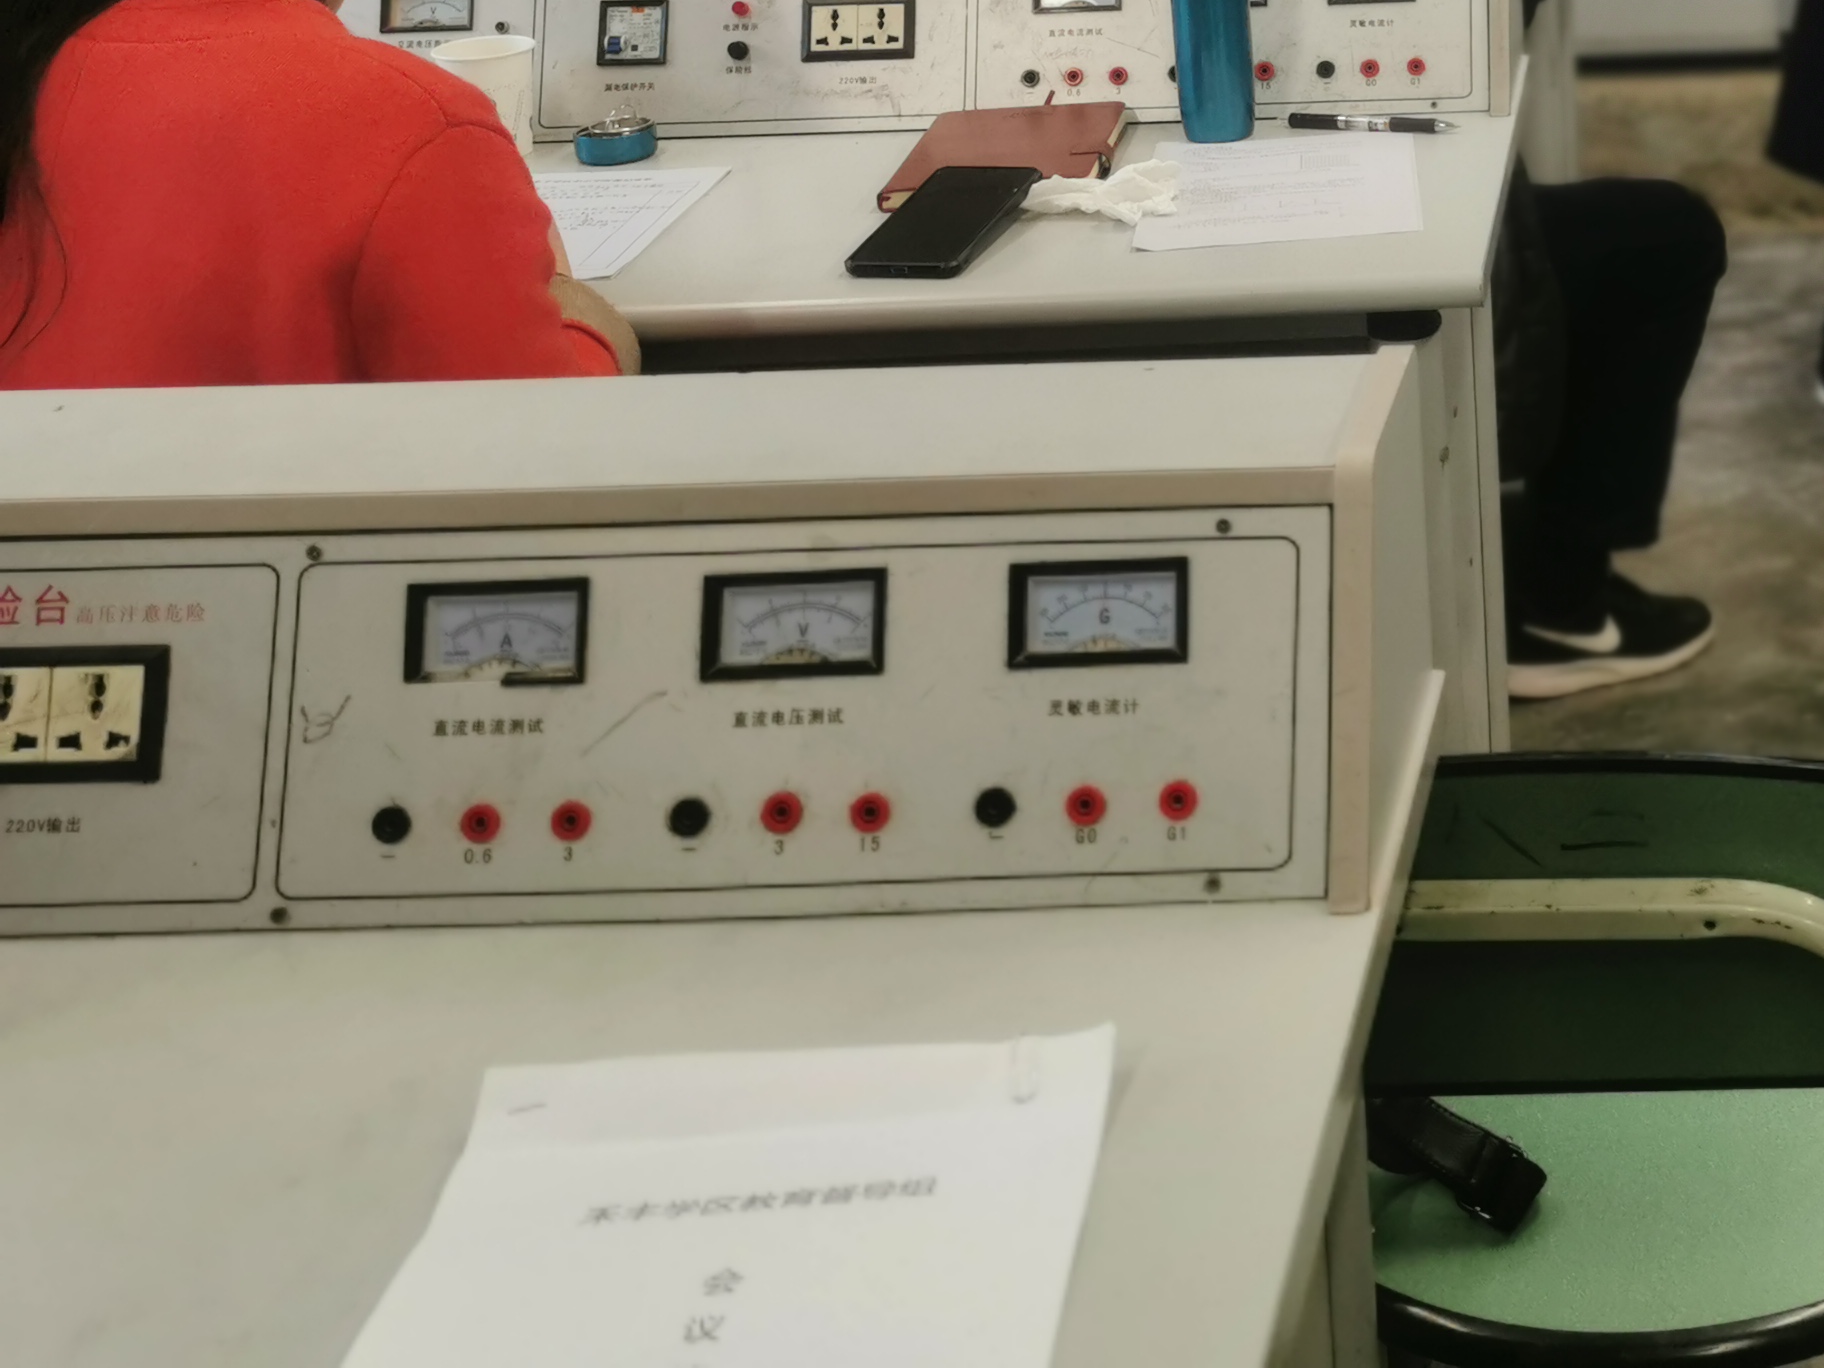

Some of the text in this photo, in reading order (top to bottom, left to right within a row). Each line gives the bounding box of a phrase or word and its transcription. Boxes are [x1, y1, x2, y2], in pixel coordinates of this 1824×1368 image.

[76, 602, 205, 624] 高压注意危险
[1099, 607, 1110, 624] G
[798, 622, 809, 638] V
[500, 632, 512, 648] A
[1048, 698, 1139, 716] 灵敏电流计
[733, 707, 844, 728] 直流电压测试
[433, 718, 544, 736] 直流电流测试
[6, 817, 81, 834] 220V输出
[1166, 825, 1186, 841] G1
[773, 840, 784, 855] 3
[859, 836, 881, 852] 15
[463, 848, 492, 864] 0.6
[563, 846, 573, 862] 3
